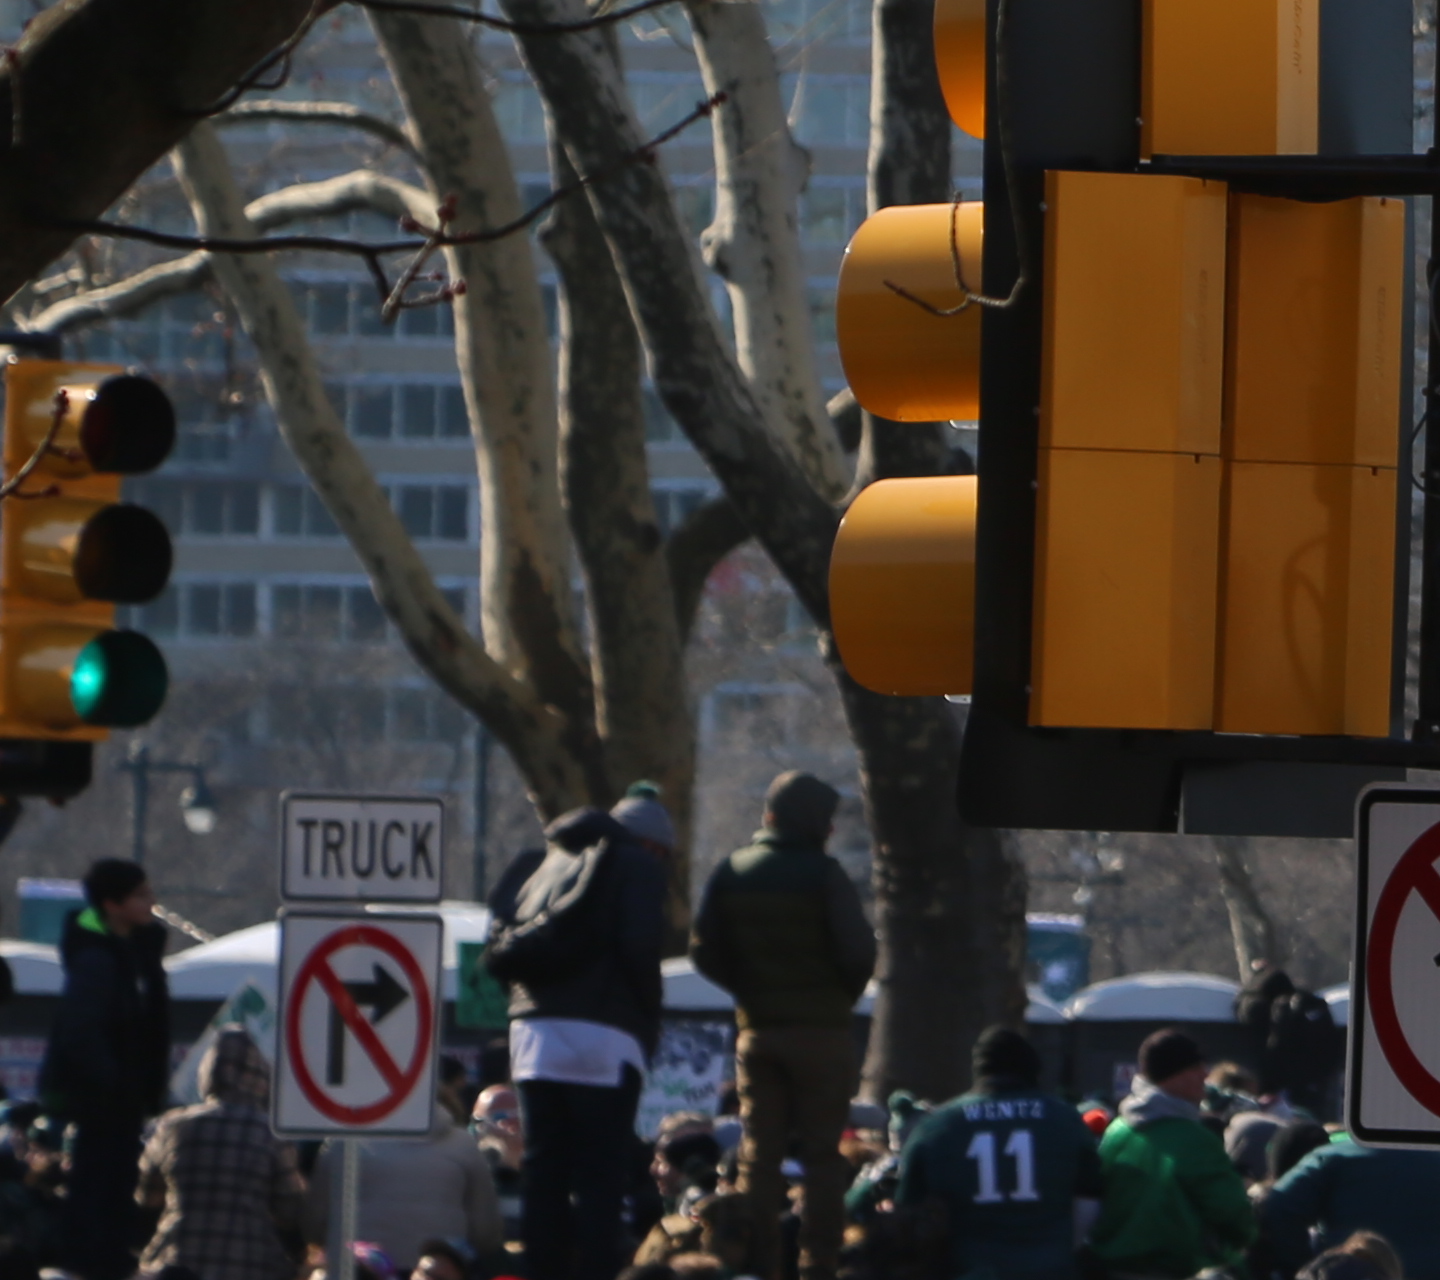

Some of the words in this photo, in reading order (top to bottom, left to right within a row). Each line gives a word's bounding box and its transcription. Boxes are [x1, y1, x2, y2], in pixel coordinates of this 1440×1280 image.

[296, 818, 435, 880] TRUCK
[963, 1100, 1043, 1121] WENTZ
[966, 1130, 1039, 1203] 11
